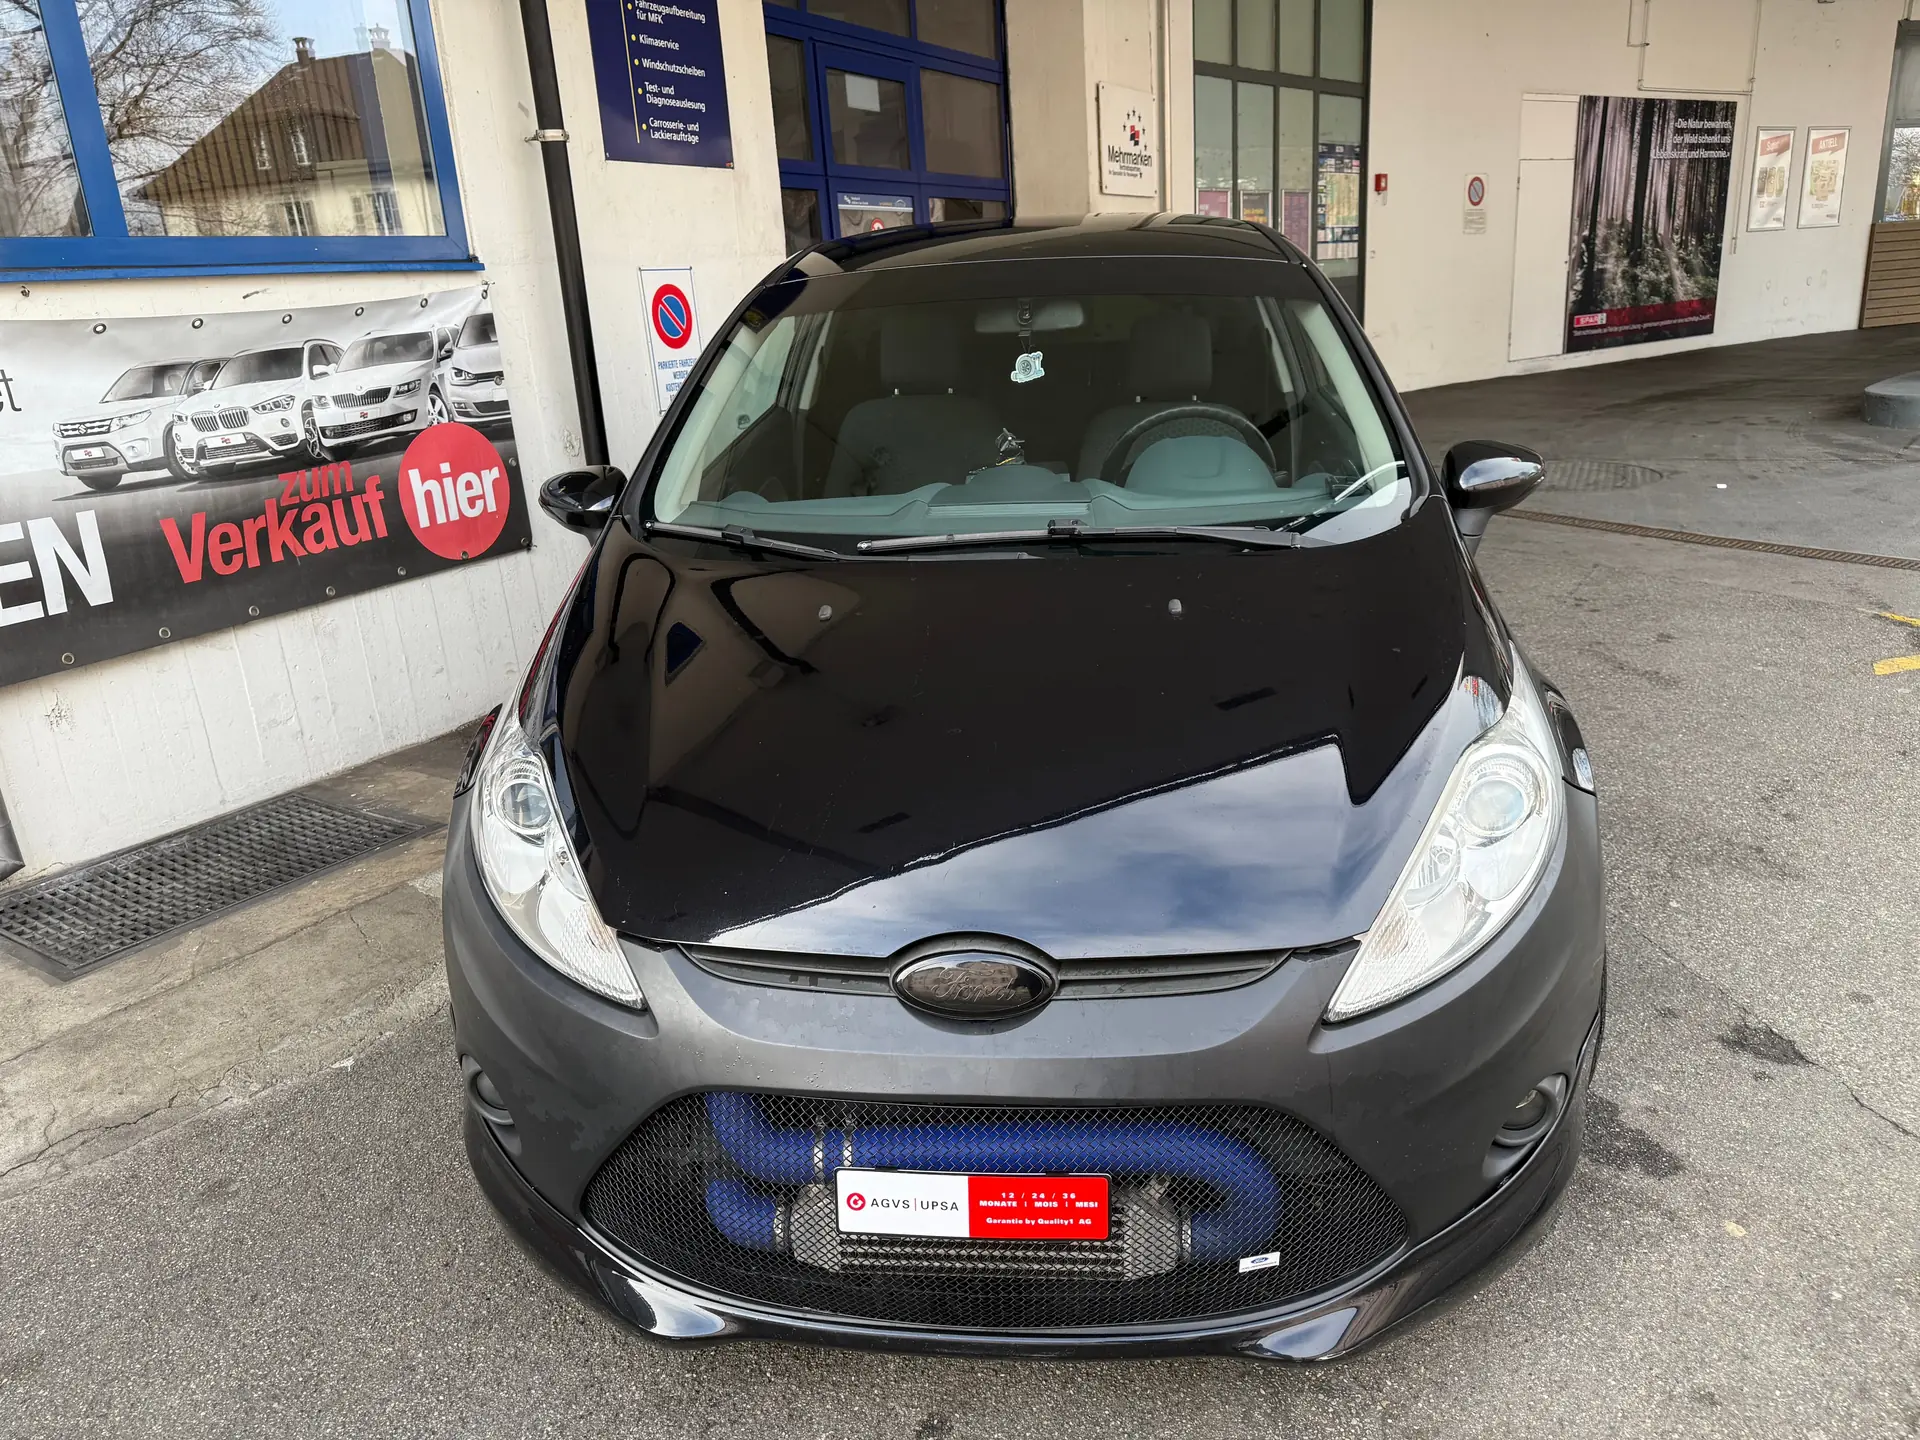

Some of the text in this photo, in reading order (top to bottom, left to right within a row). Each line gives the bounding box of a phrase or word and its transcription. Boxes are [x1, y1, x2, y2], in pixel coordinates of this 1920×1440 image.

[634, 0, 706, 23] Fahrzeugaufbereitung
[636, 9, 664, 24] für MFK
[639, 34, 679, 50] Klimaservice
[642, 58, 705, 77] Windschutzscheiben
[644, 82, 674, 95] Test- und
[646, 94, 705, 112] Diagnoseauslesung
[649, 117, 699, 131] Carrosserie- und
[1688, 119, 1704, 128] Natur
[651, 130, 699, 144] Lackieraufträge
[1673, 134, 1683, 143] der
[1683, 133, 1698, 143] Wald
[1699, 134, 1720, 143] schenkt
[1108, 144, 1152, 167] Mehrmarken
[1688, 149, 1699, 158] und
[278, 460, 353, 506] zum
[408, 463, 500, 528] hier
[160, 475, 388, 584] Verkauf
[871, 1198, 959, 1211] AGVS UPSA
